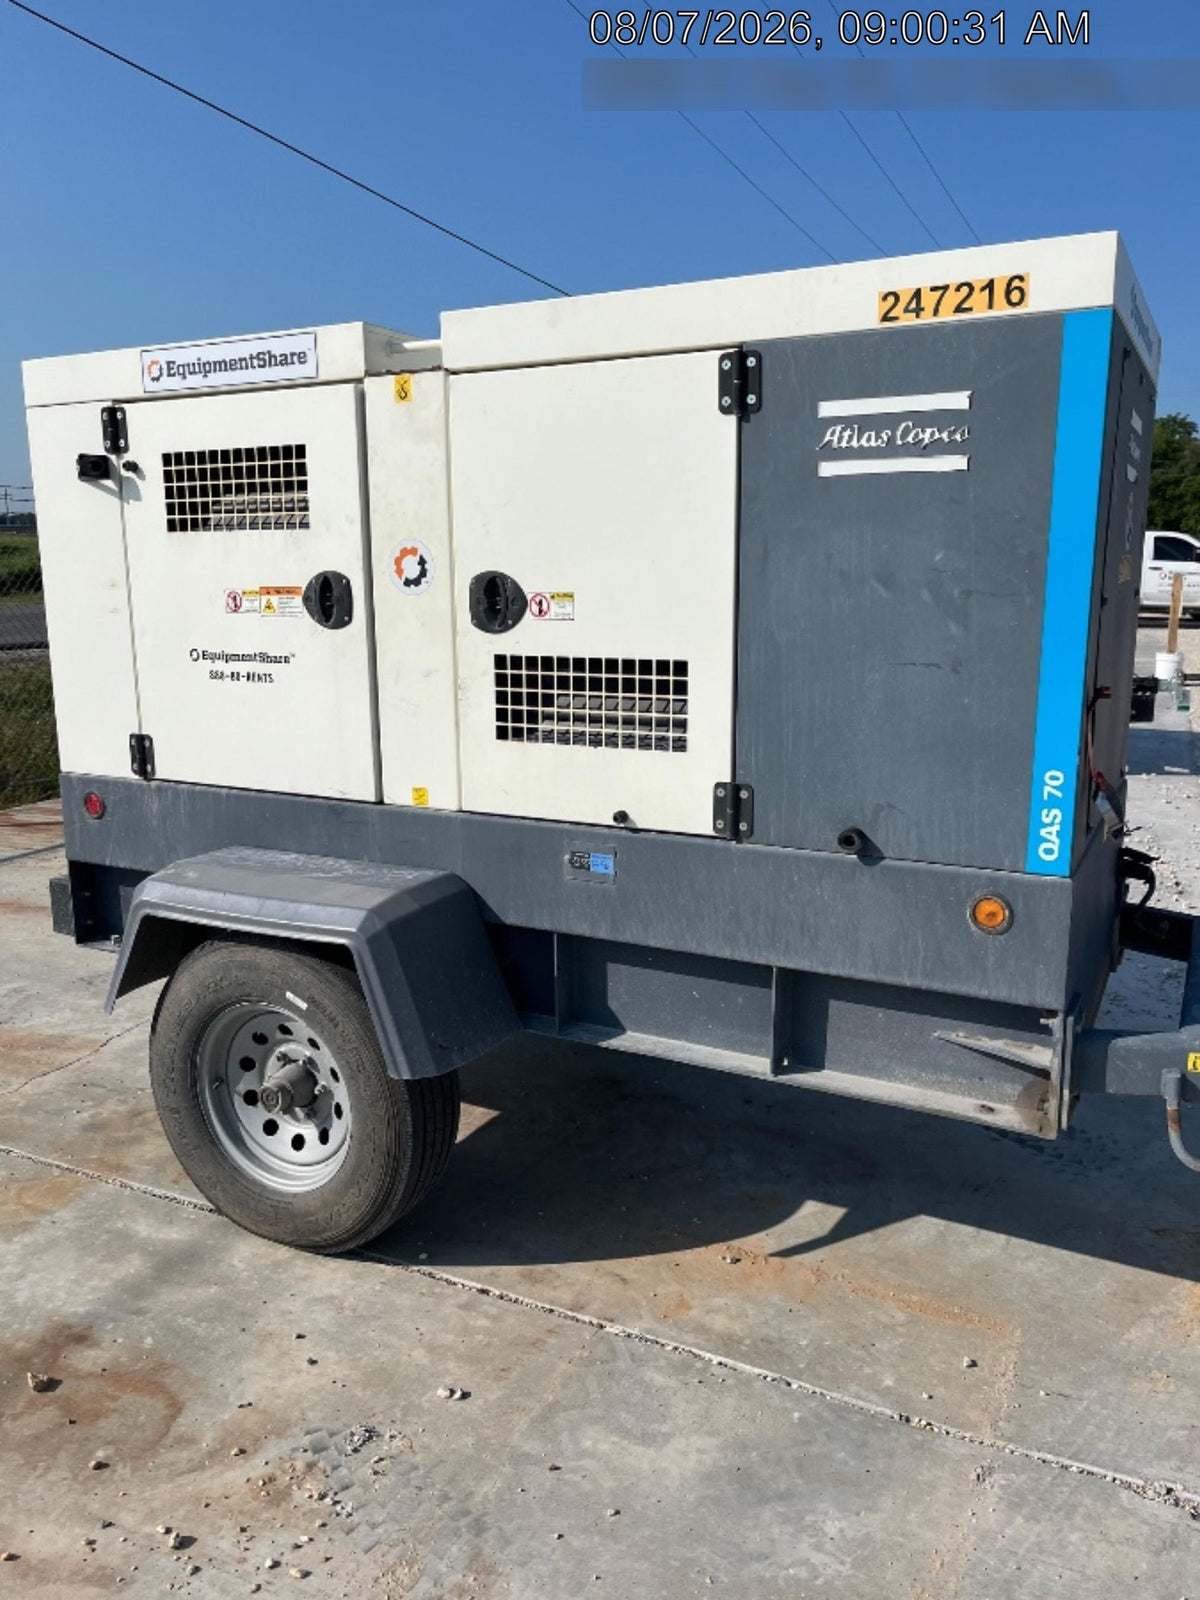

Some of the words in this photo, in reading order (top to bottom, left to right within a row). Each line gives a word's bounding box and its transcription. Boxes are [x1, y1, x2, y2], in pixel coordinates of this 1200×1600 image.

[880, 274, 1026, 323] 247216
[166, 349, 308, 379] EquipmentShare
[816, 424, 892, 451] Atlas
[896, 421, 970, 450] Copco
[1043, 769, 1065, 801] 70
[1038, 808, 1063, 861] QAS
